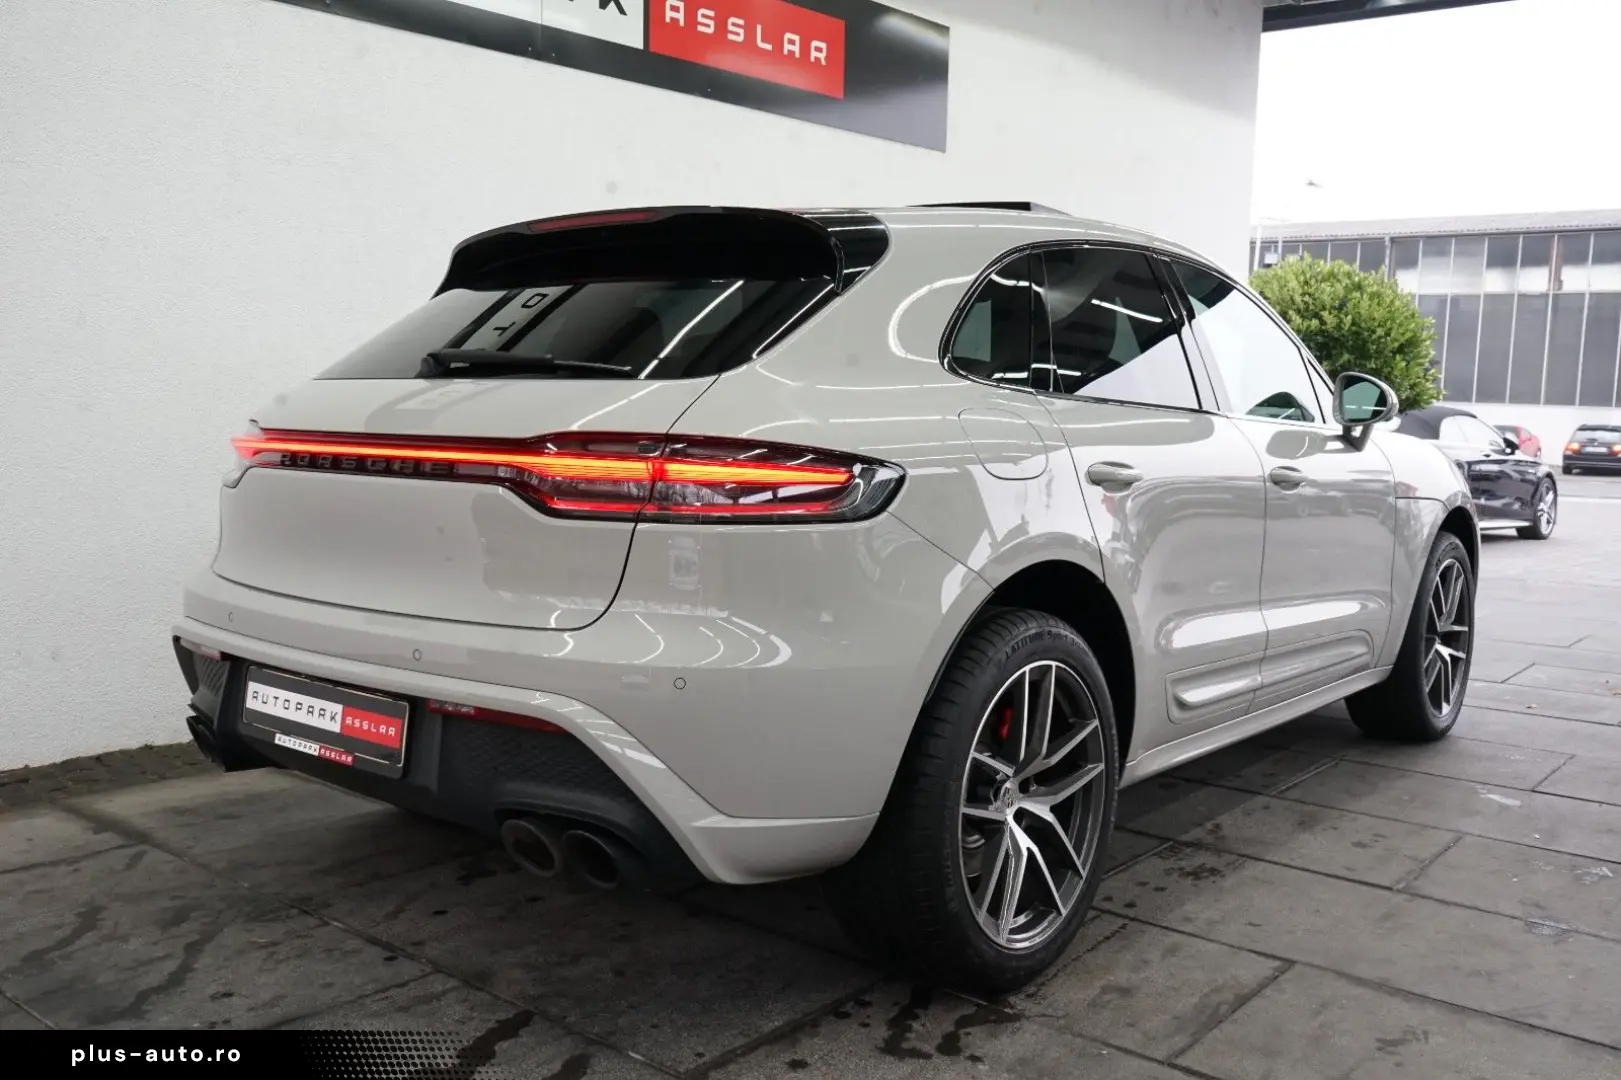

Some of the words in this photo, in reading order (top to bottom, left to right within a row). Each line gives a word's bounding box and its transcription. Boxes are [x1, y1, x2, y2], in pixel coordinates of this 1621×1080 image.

[665, 0, 827, 65] ASSLAR
[252, 690, 339, 724] AUTOPARK
[345, 716, 396, 737] ASSLAR
[277, 736, 318, 752] AUTOPARK
[320, 748, 353, 762] ASSLAR
